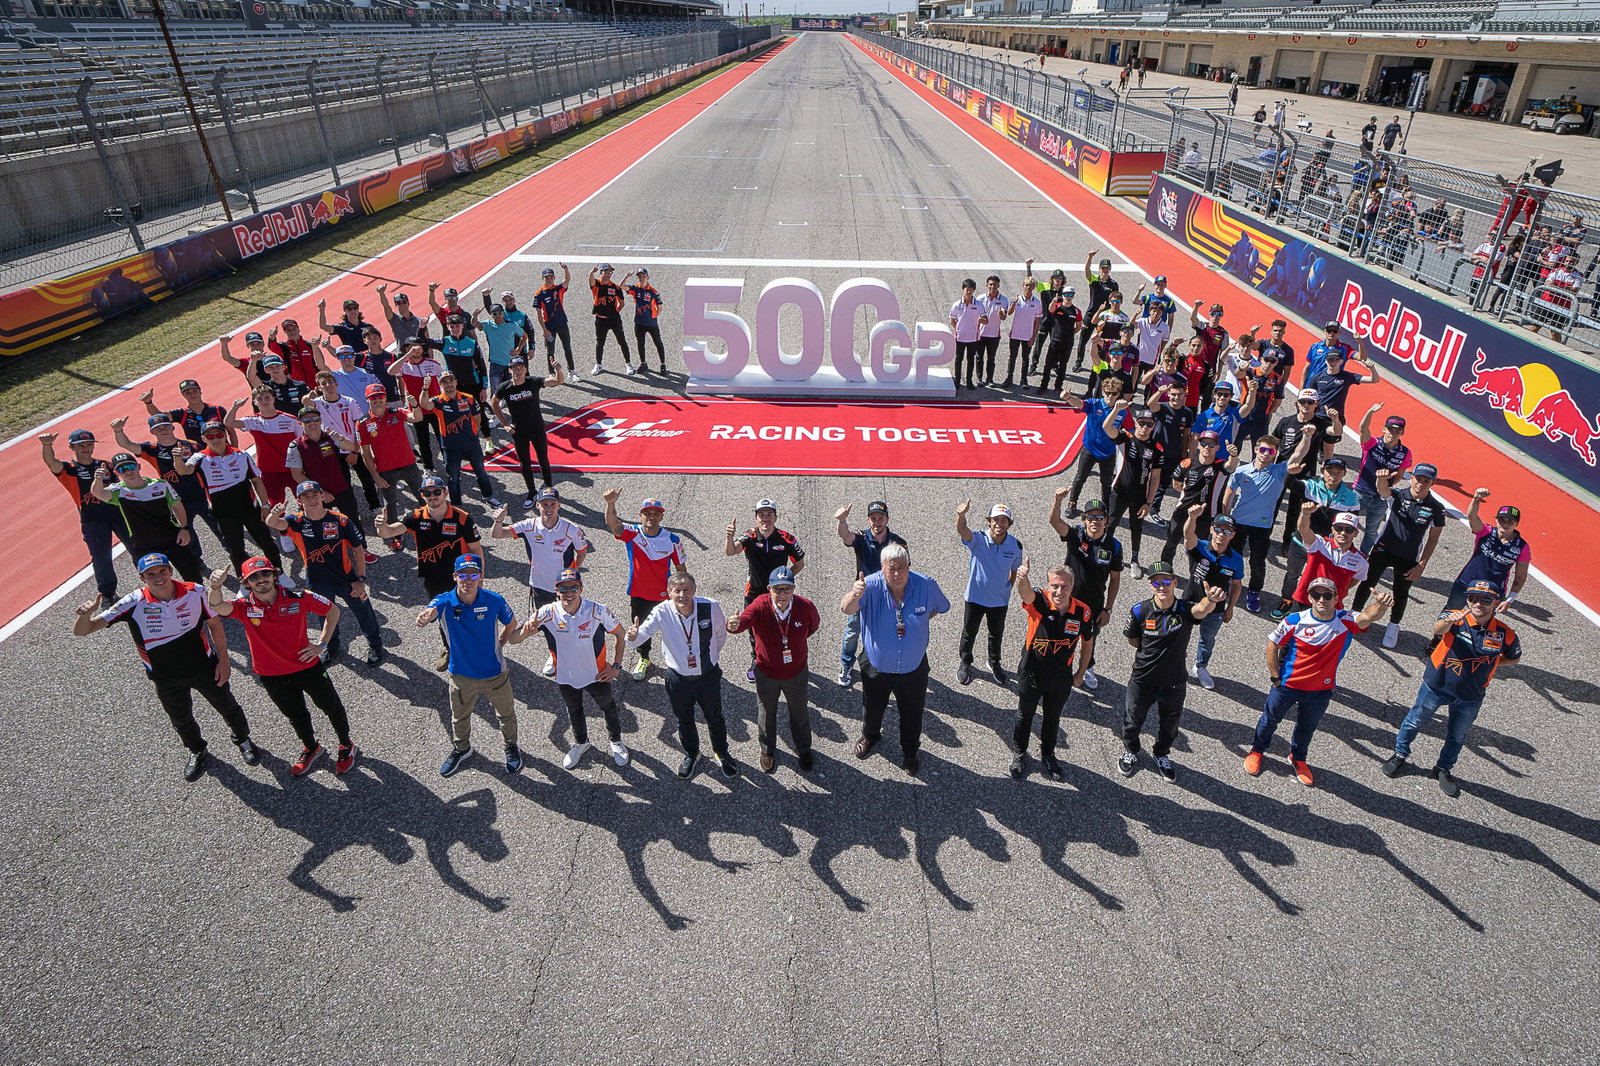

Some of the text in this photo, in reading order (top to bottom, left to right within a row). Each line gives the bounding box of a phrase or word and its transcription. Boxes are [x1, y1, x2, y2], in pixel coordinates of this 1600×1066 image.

[509, 389, 533, 401] aprilia
[709, 425, 1046, 445] RACING TOGETHER
